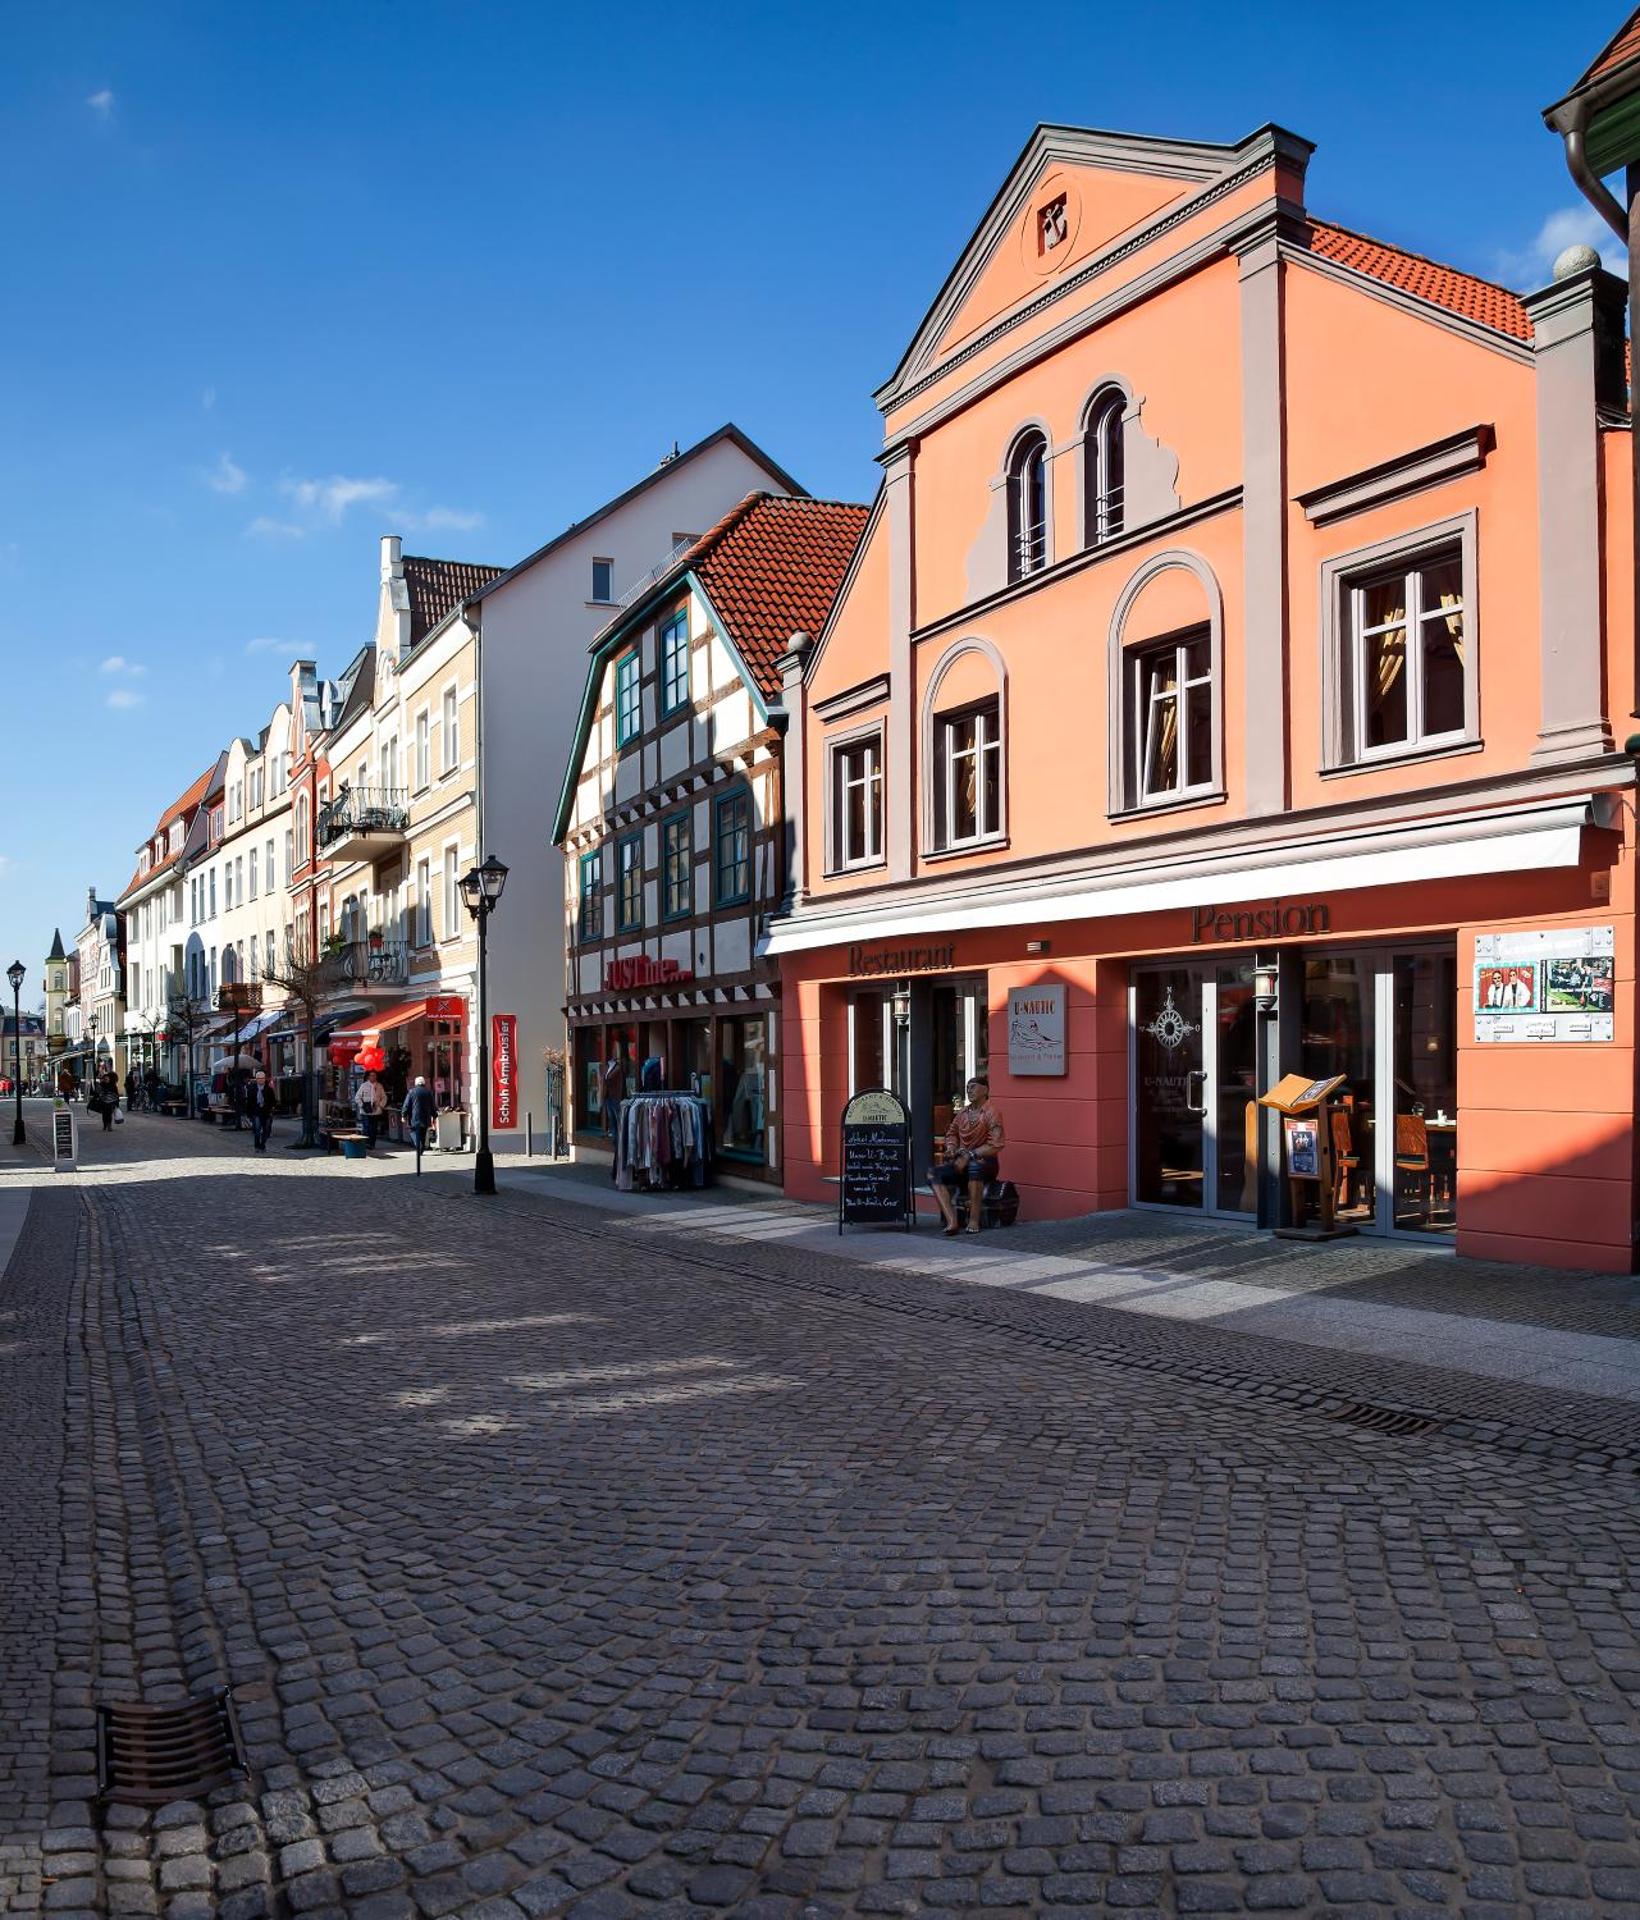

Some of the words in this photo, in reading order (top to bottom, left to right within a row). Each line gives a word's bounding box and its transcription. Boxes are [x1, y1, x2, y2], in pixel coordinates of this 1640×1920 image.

[1191, 899, 1330, 944] Pension
[848, 944, 956, 977] Restaurant
[499, 1021, 510, 1084] Armbruster
[1144, 1076, 1187, 1087] U-NAUTI
[499, 1089, 510, 1123] Schuh
